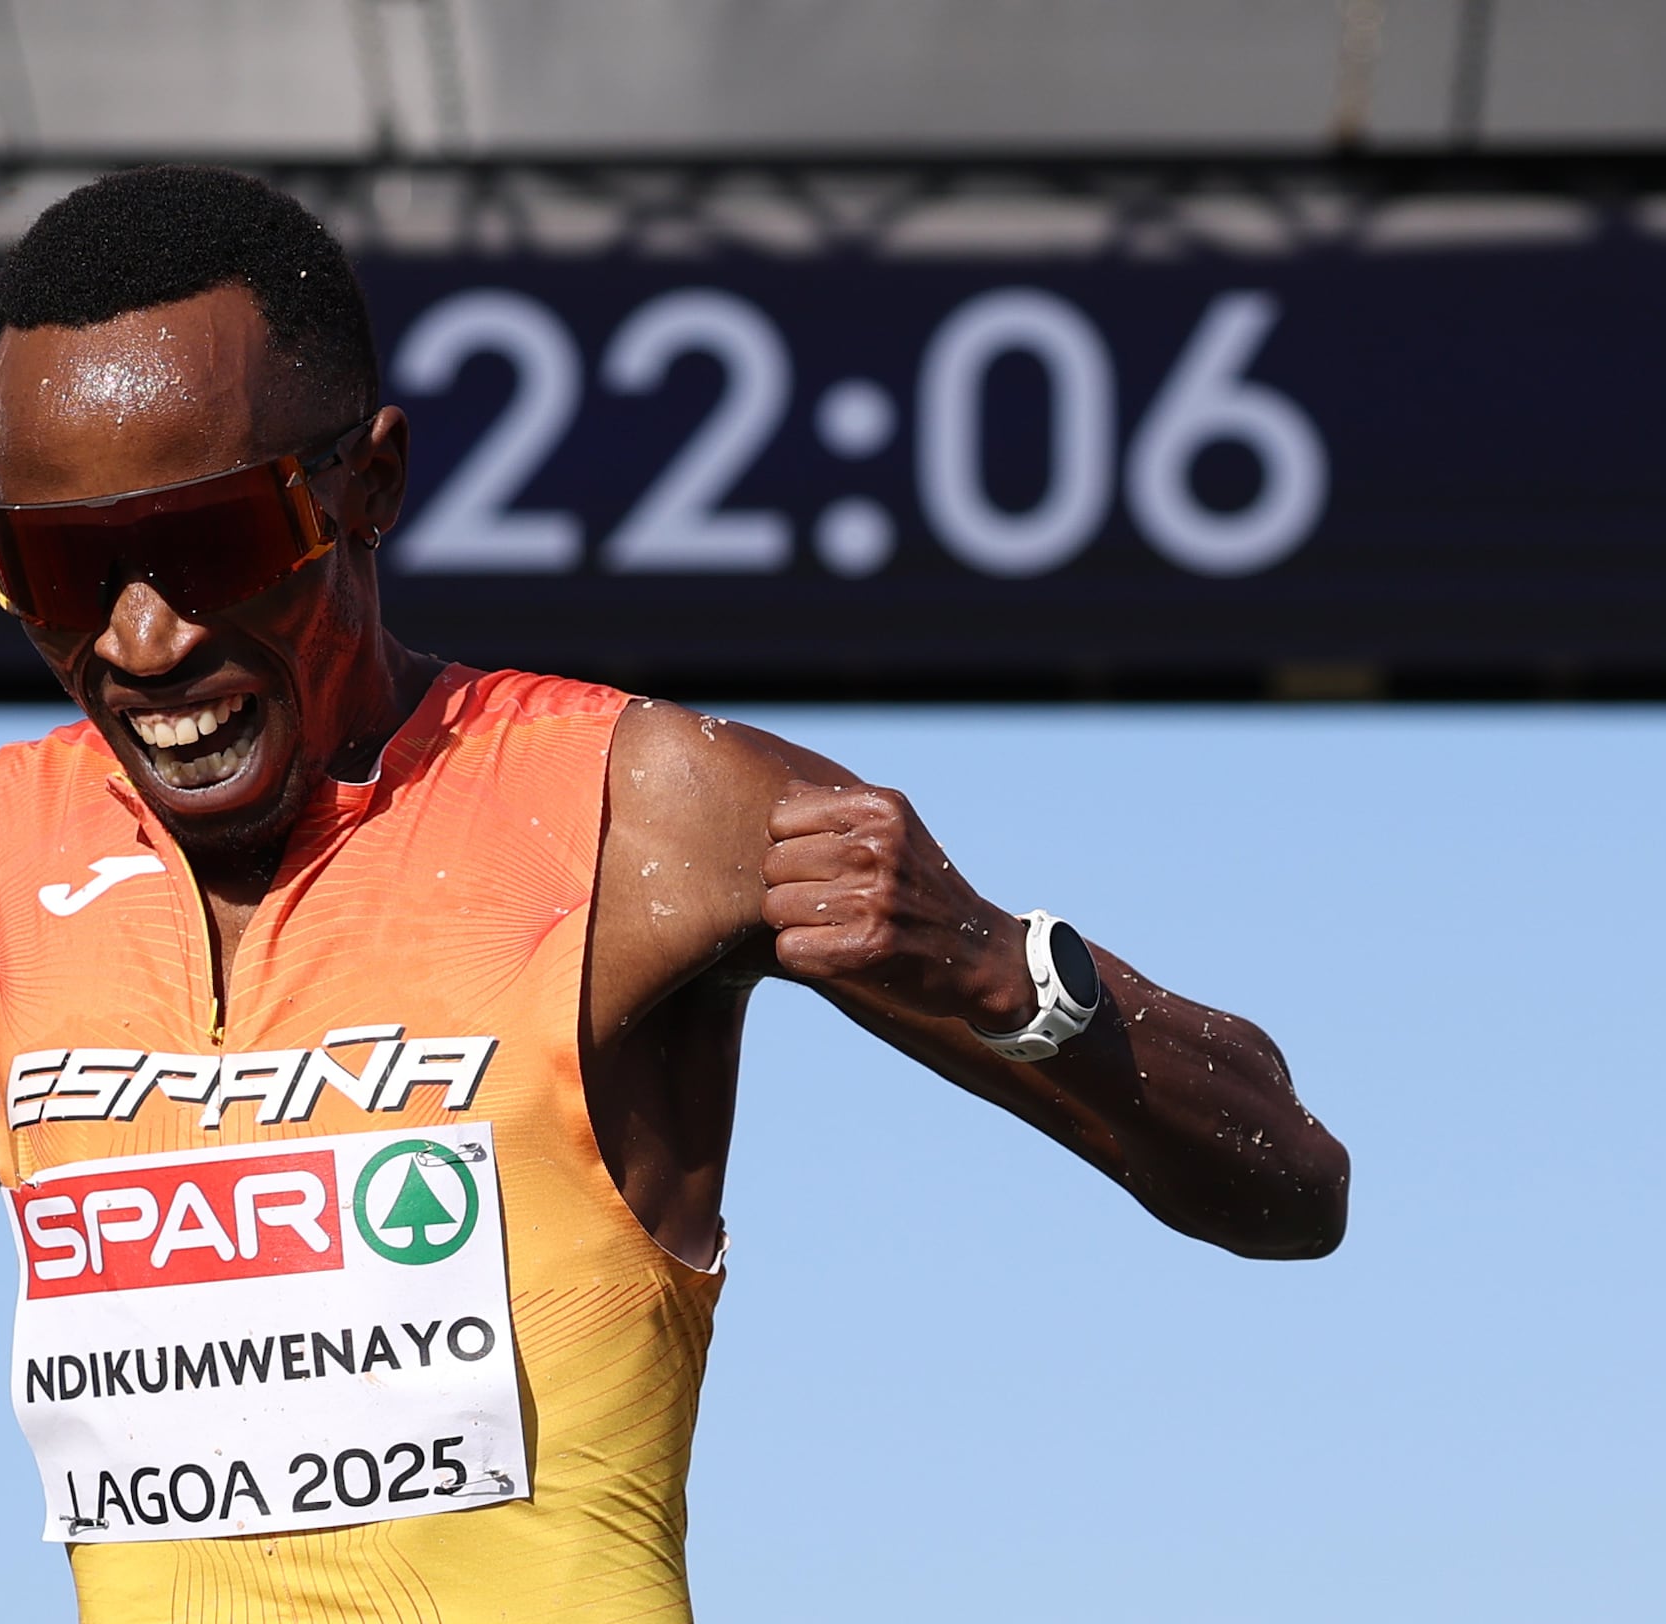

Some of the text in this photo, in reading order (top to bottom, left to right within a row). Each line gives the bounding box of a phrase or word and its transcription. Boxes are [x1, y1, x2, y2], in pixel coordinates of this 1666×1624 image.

[390, 286, 1329, 580] 22:06
[6, 1023, 499, 1131] ESPAÑA
[24, 1169, 331, 1281] SPAR
[26, 1316, 496, 1403] NDIKUMWENAYO
[67, 1435, 468, 1527] LAGOA 2025
